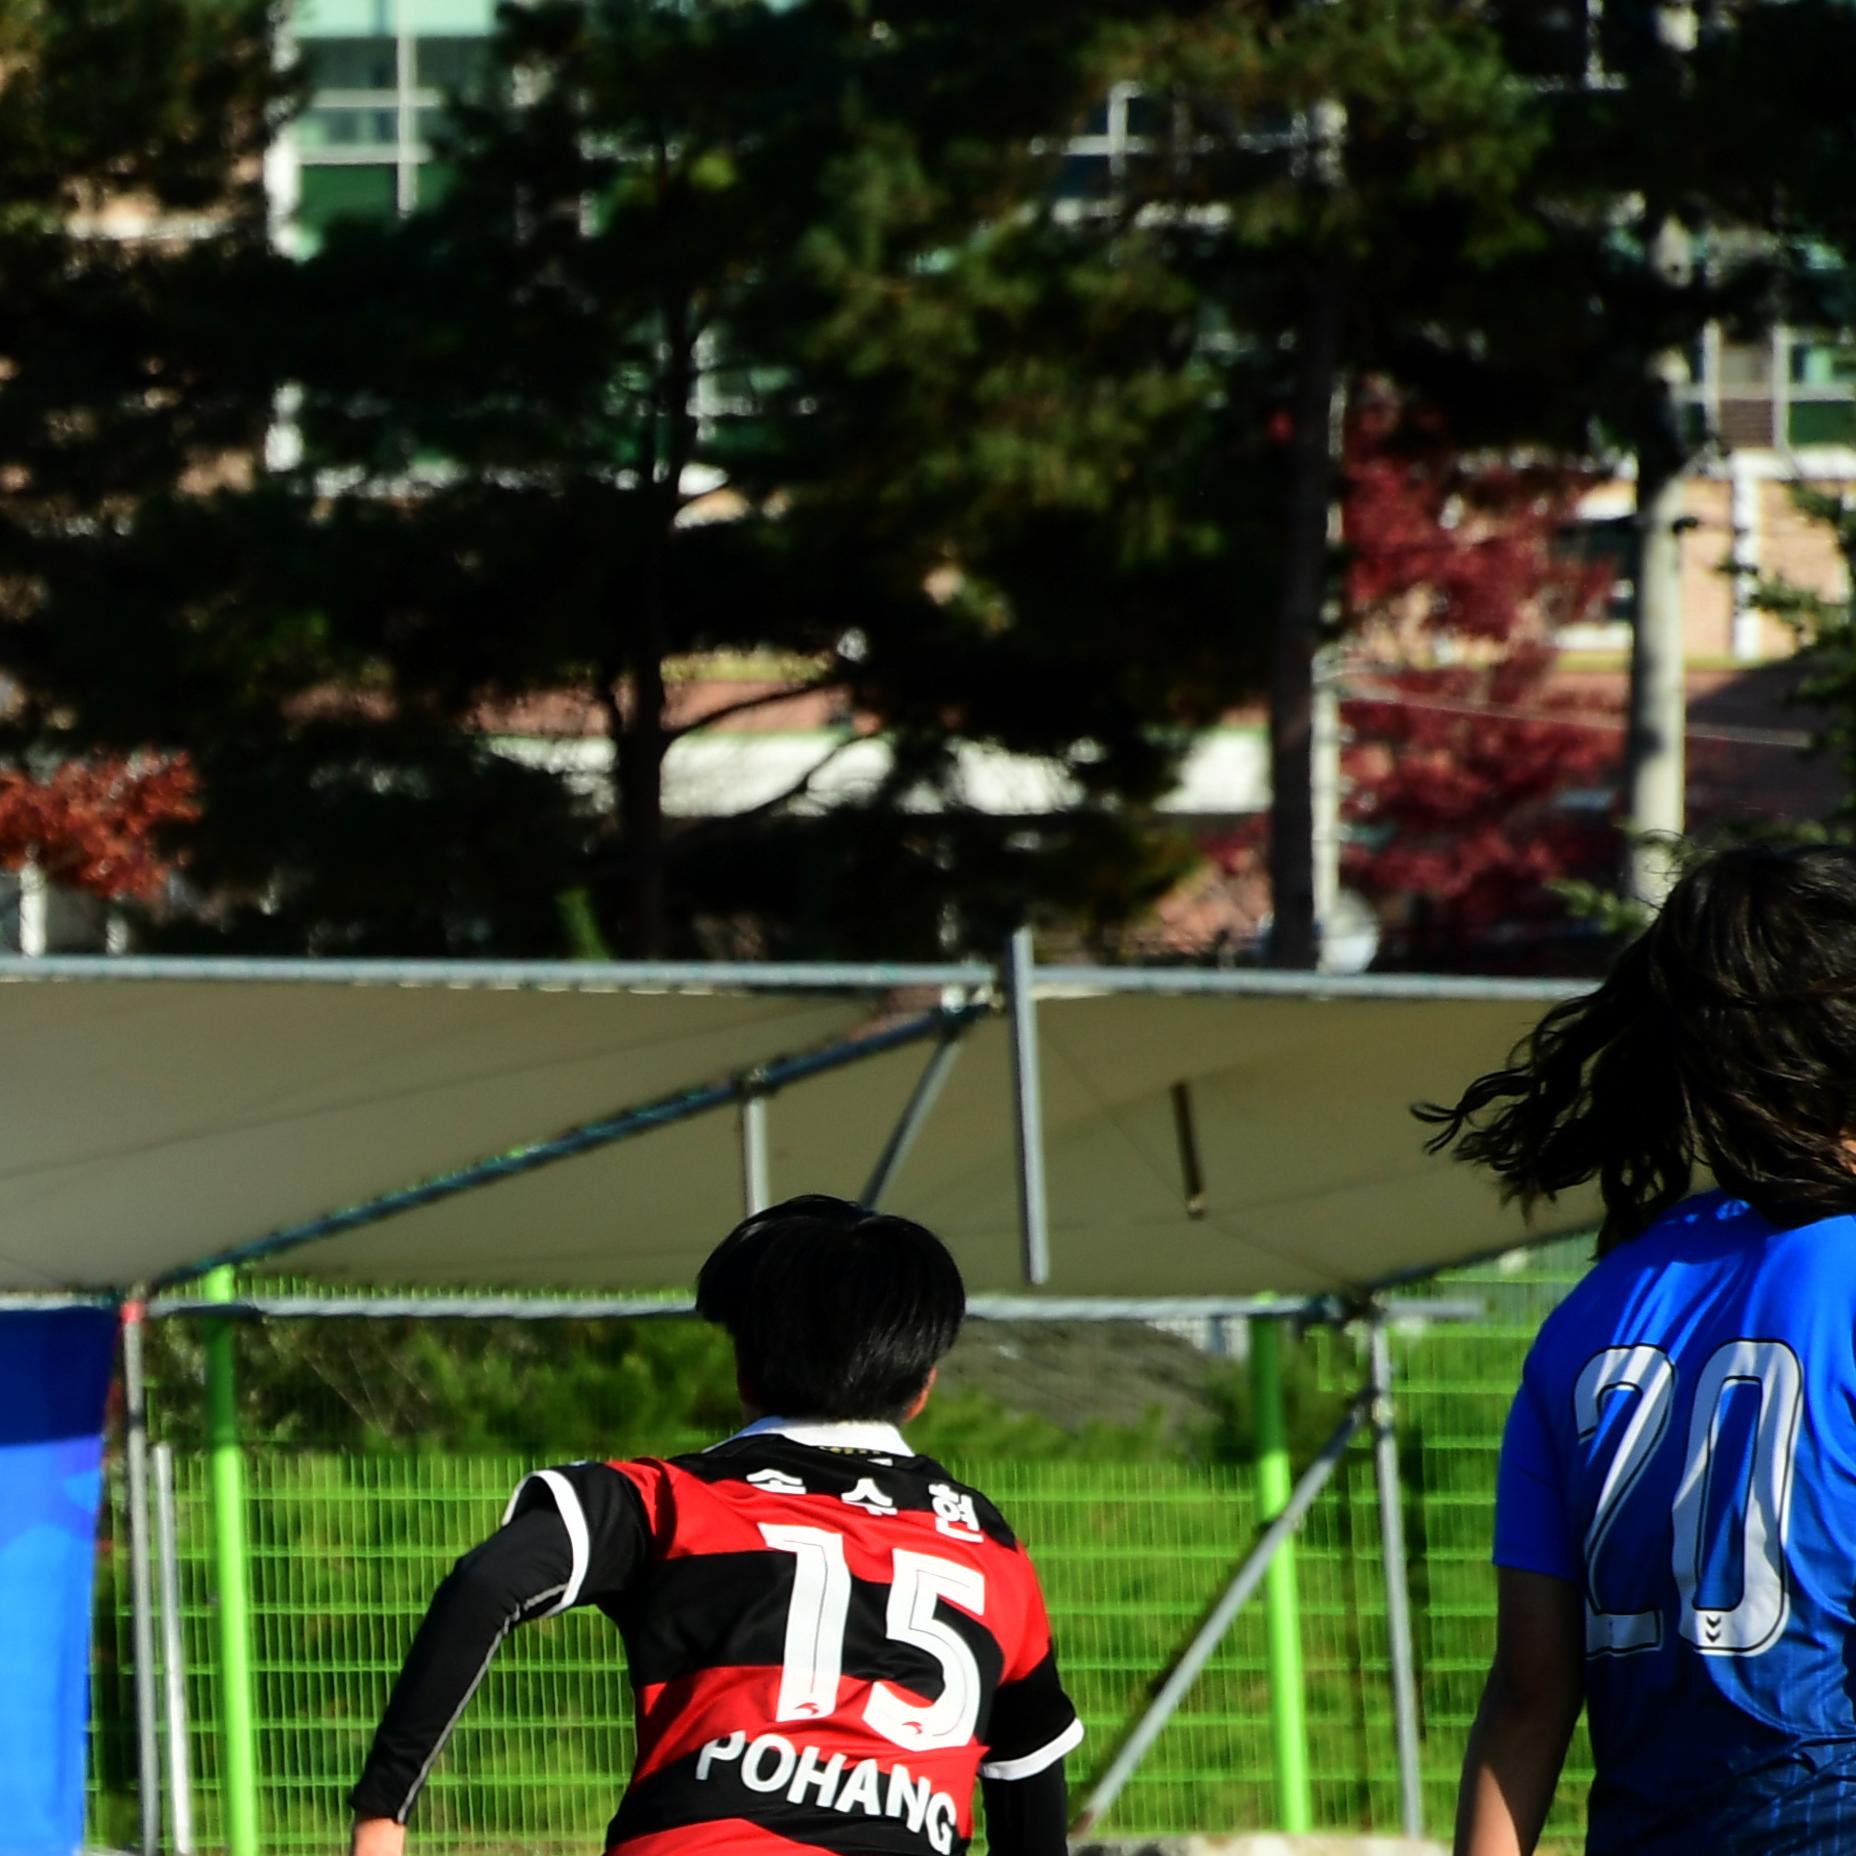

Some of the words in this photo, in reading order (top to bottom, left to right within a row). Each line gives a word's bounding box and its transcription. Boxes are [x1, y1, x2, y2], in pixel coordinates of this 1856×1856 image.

[1574, 1338, 1804, 1659] 20
[758, 1522, 985, 1752] 15
[696, 1730, 958, 1855] POHANG
